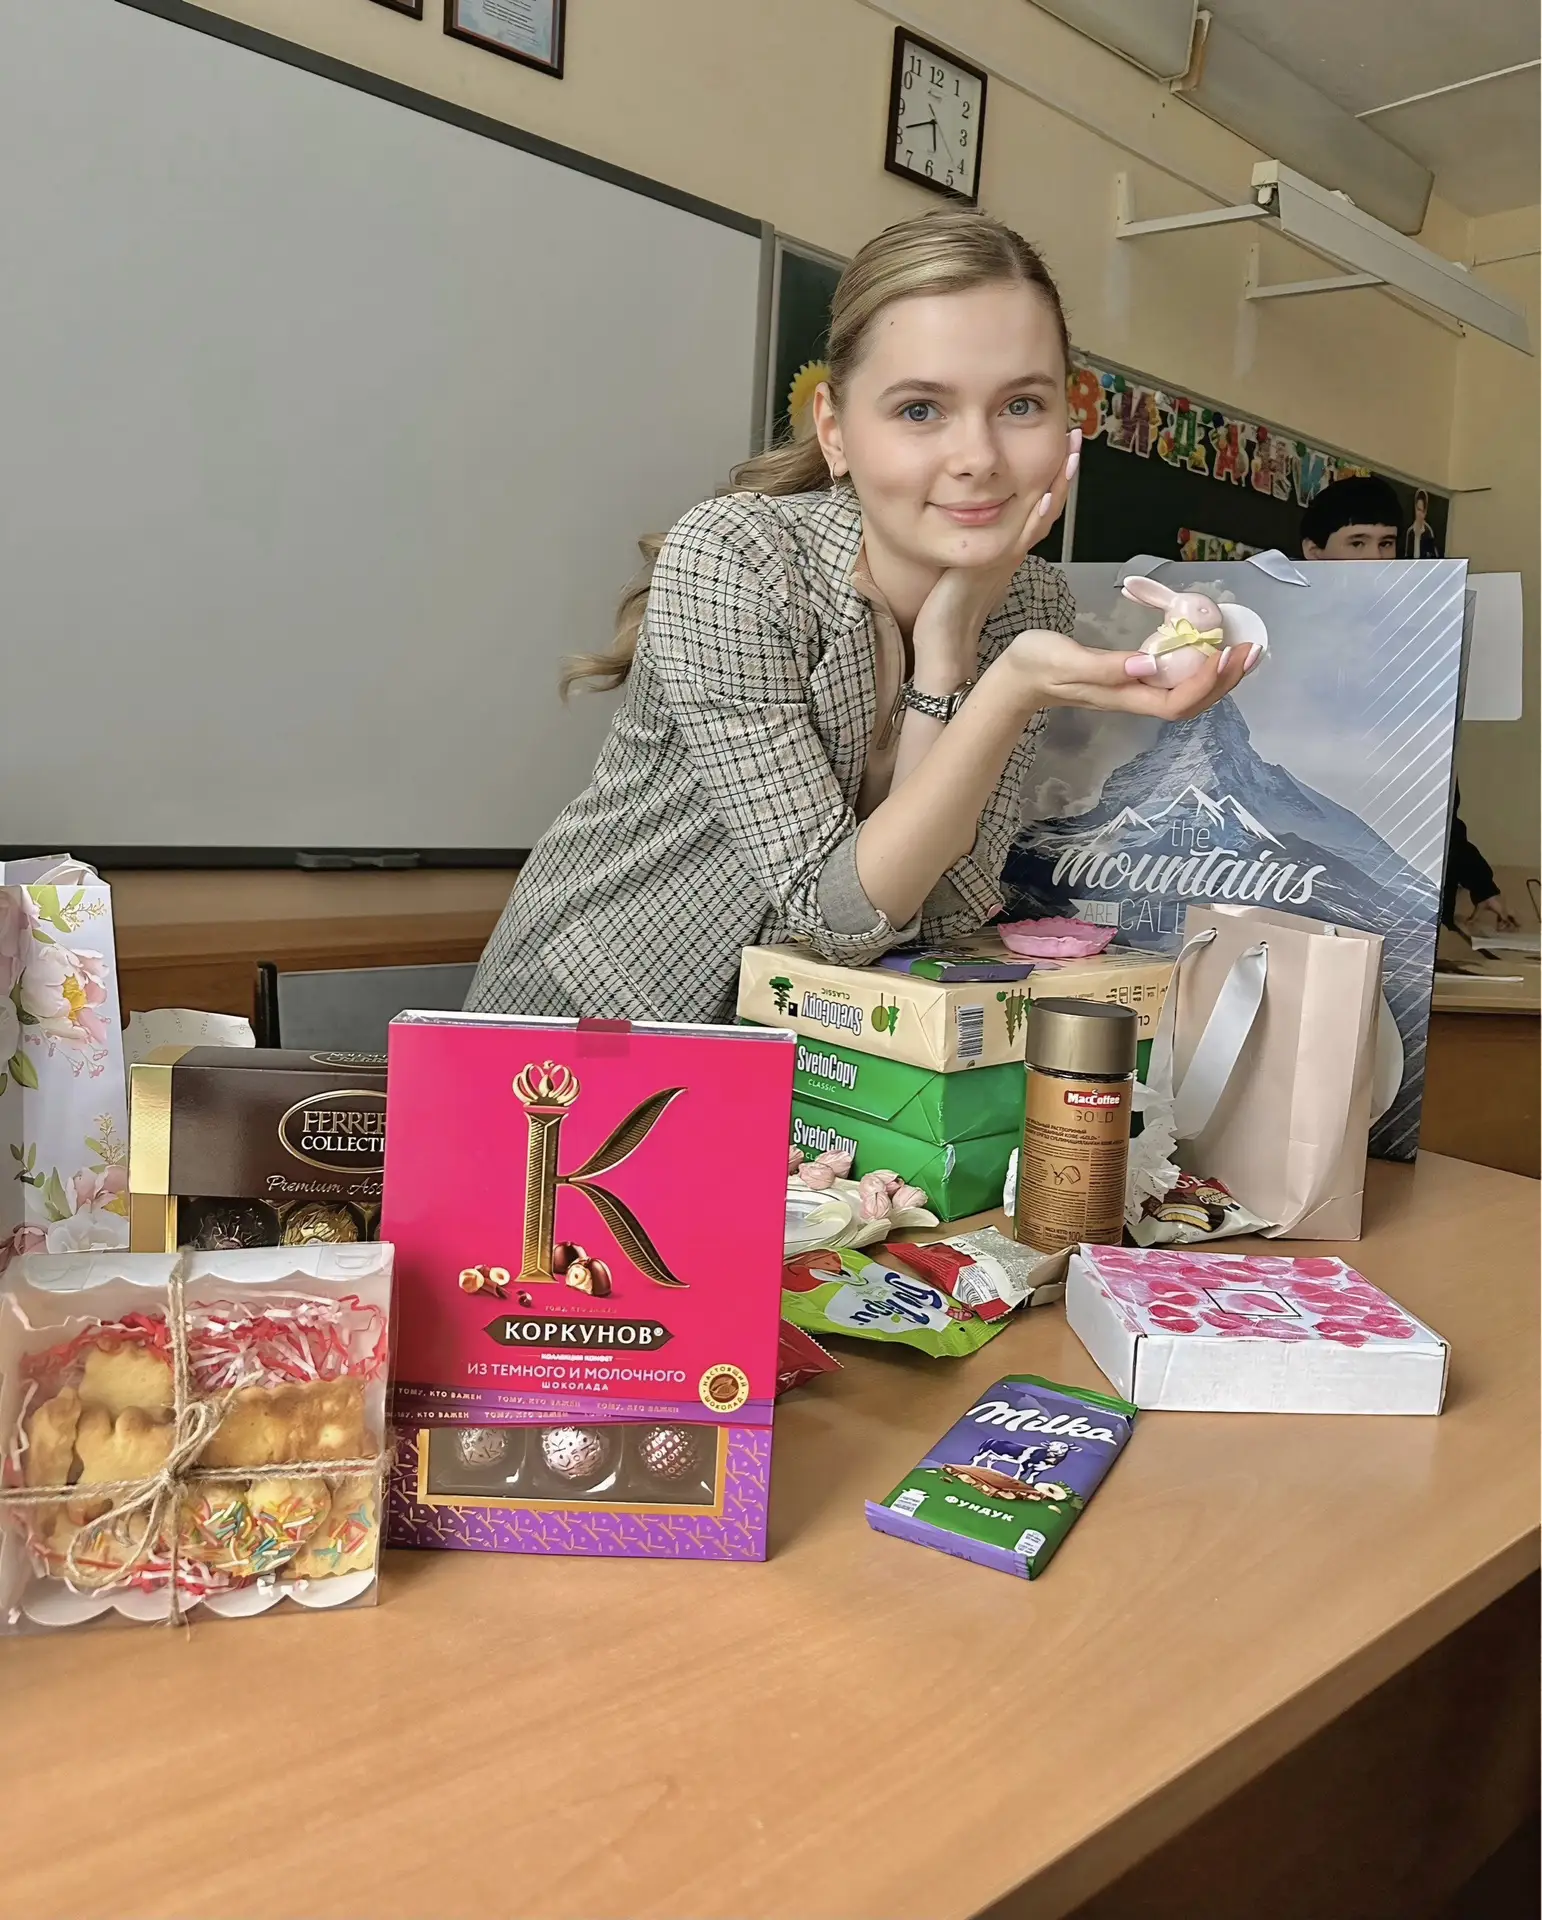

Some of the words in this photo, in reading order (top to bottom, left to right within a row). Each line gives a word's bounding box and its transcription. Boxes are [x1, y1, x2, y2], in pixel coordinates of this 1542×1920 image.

[901, 71, 913, 90] 0
[930, 66, 944, 88] 12
[962, 101, 970, 119] 2
[959, 129, 968, 147] 3
[906, 150, 913, 168] 7
[925, 159, 934, 177] 6
[1170, 819, 1210, 848] the
[1083, 902, 1114, 923] ARE
[821, 987, 850, 1000] CLASSIC
[801, 990, 863, 1036] SvetoCopy
[797, 1045, 858, 1090] SvetoCopy
[808, 1078, 837, 1093] CLASSIC
[1067, 1092, 1120, 1106] MacCoffee
[1072, 1109, 1114, 1123] GOLD
[266, 1175, 344, 1194] Premium
[467, 1362, 488, 1376] ИЗ
[491, 1363, 566, 1379] ТЕМНОГО
[569, 1366, 580, 1379] И
[584, 1367, 686, 1383] МОЛОЧНОГО
[429, 1390, 448, 1398] КТО
[450, 1391, 482, 1400] ВАЖЕН
[541, 1381, 609, 1391] ШОКОЛАДА
[704, 1394, 744, 1411] ШОКОЛАД
[417, 1411, 435, 1419] КТО
[438, 1411, 470, 1419] ВАЖЕН
[966, 1401, 1118, 1446] Milka
[945, 1494, 1014, 1523] ФУНДУК
